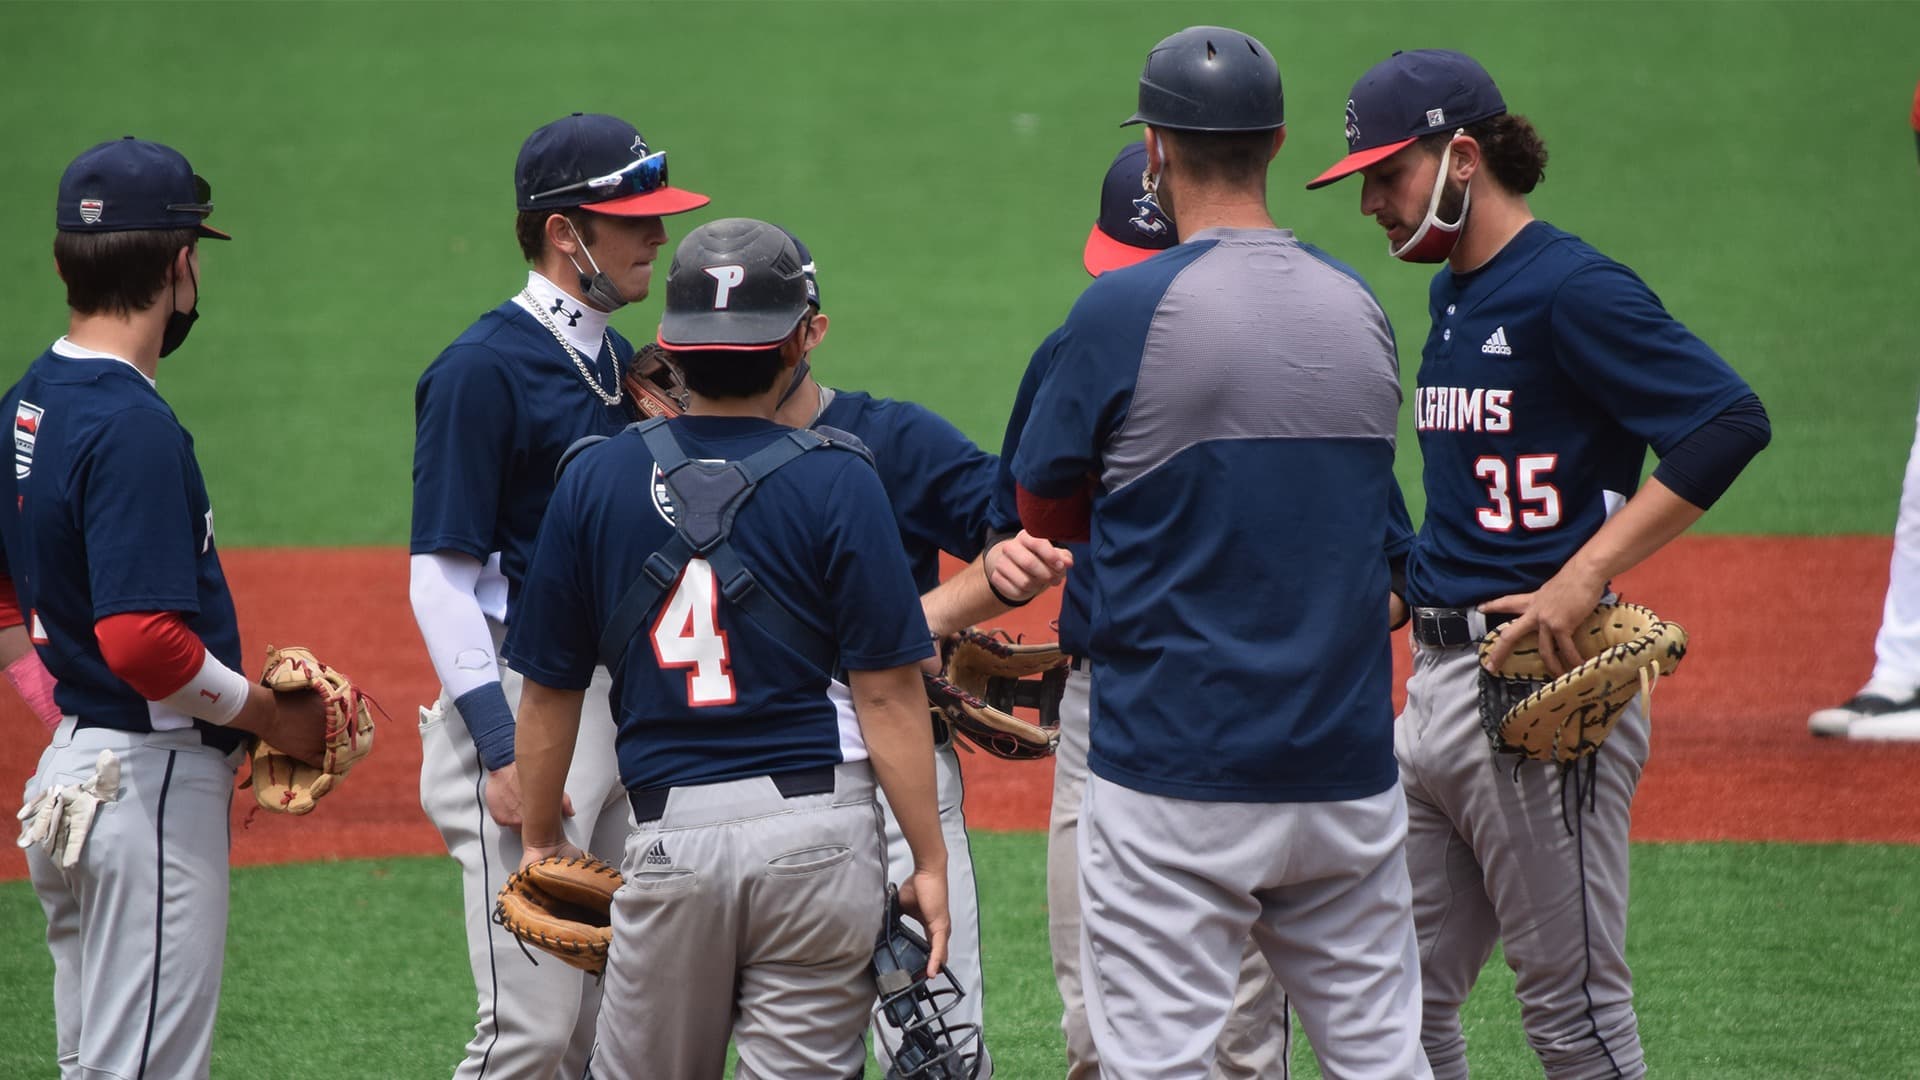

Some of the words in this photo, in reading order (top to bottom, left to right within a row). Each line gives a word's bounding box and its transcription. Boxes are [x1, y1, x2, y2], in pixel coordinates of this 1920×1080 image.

[700, 263, 746, 311] P
[1481, 344, 1512, 356] adidas
[1473, 453, 1563, 533] 35
[649, 553, 737, 708] 4
[200, 688, 221, 704] 1
[646, 856, 672, 865] adidas
